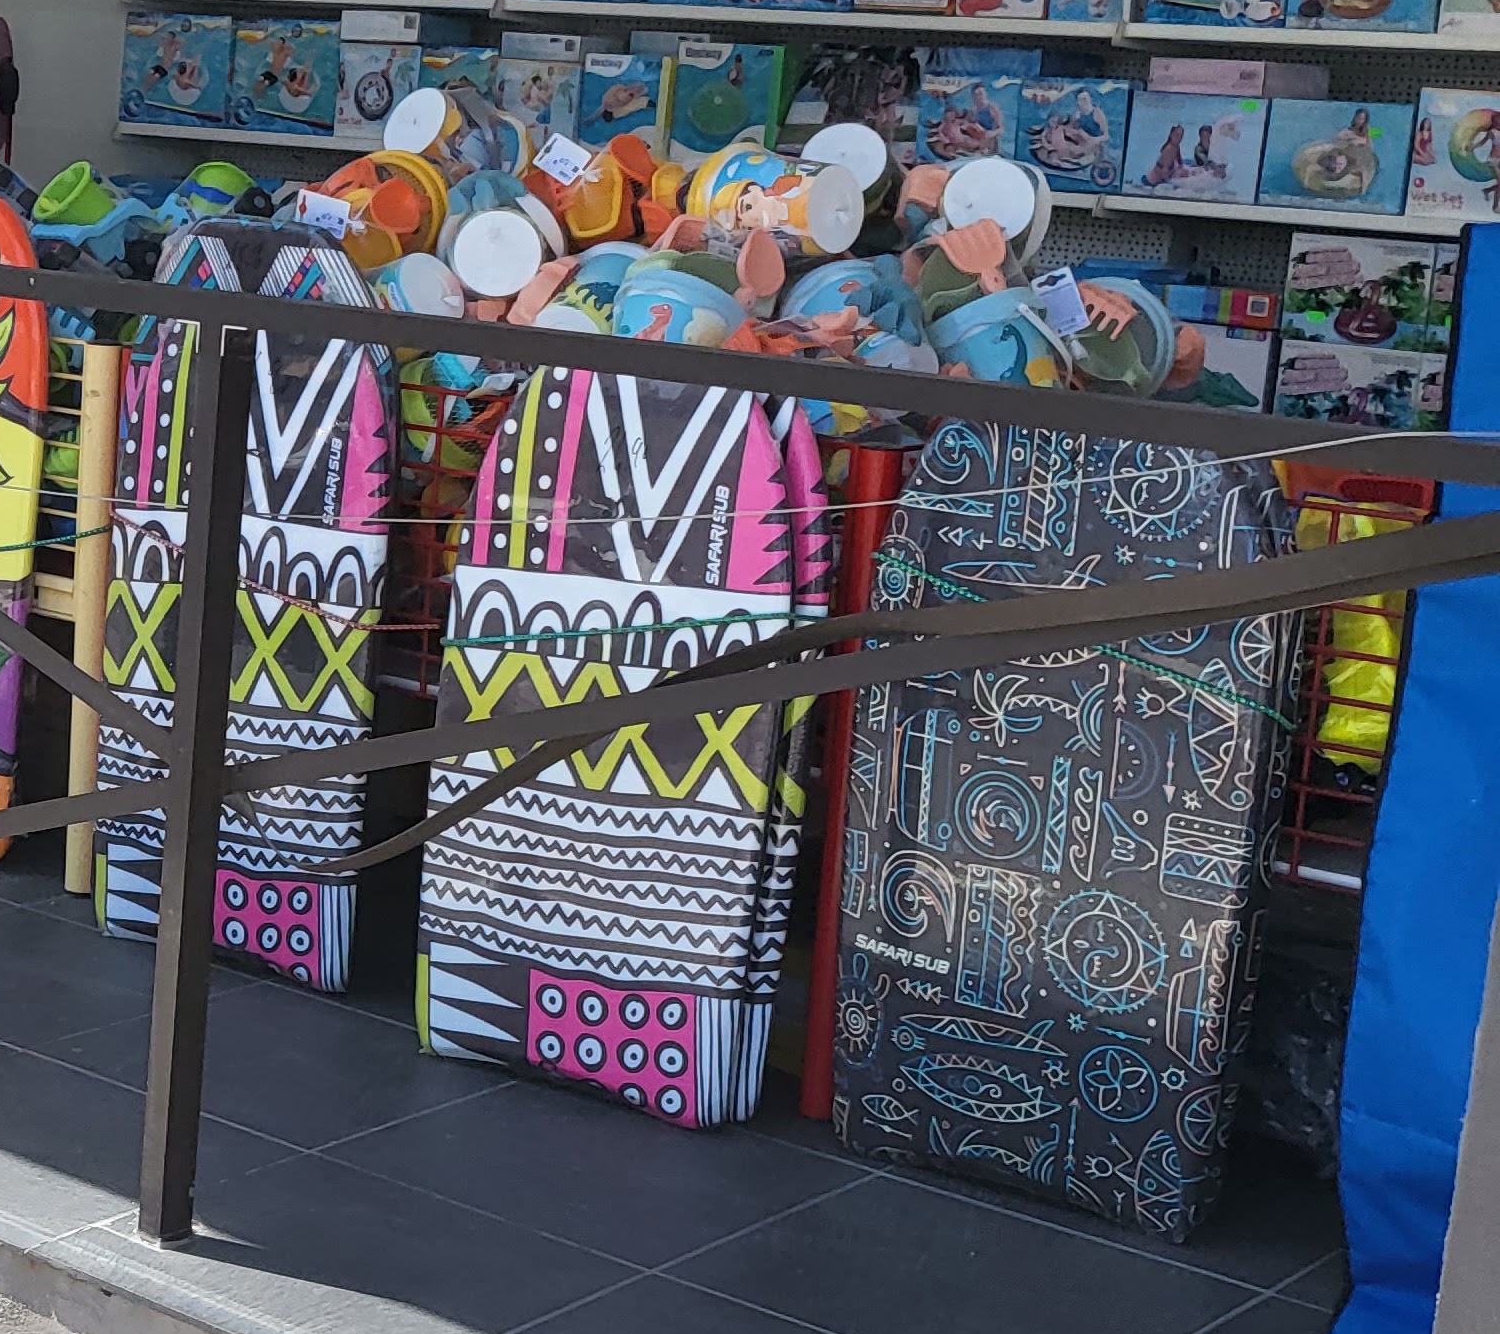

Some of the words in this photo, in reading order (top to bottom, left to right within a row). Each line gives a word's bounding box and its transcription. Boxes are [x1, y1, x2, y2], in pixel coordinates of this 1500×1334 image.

[713, 485, 730, 523] SUB
[706, 524, 728, 586] SAFARI
[854, 933, 913, 966] SAFARI
[913, 954, 950, 974] SUB
